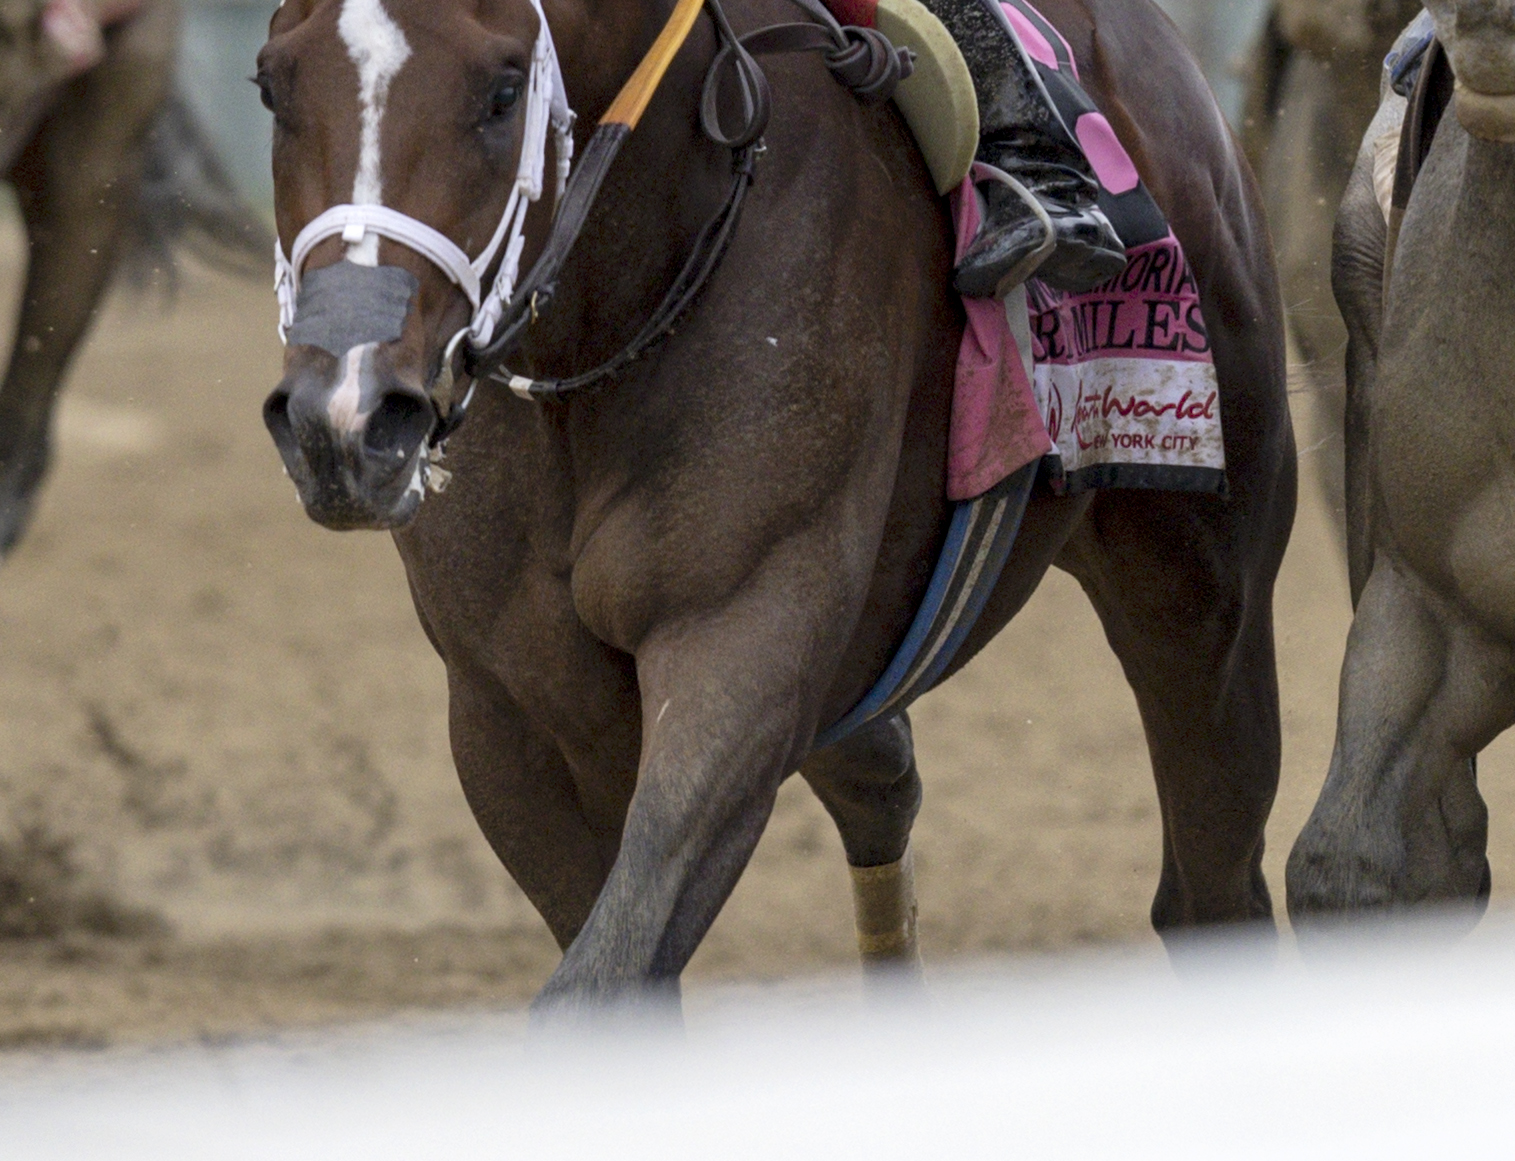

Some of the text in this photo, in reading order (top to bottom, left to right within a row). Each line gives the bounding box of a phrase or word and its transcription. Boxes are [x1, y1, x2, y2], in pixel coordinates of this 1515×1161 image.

[1067, 299, 1210, 358] MILES
[1110, 433, 1155, 450] YORK
[1161, 435, 1198, 451] CITY
